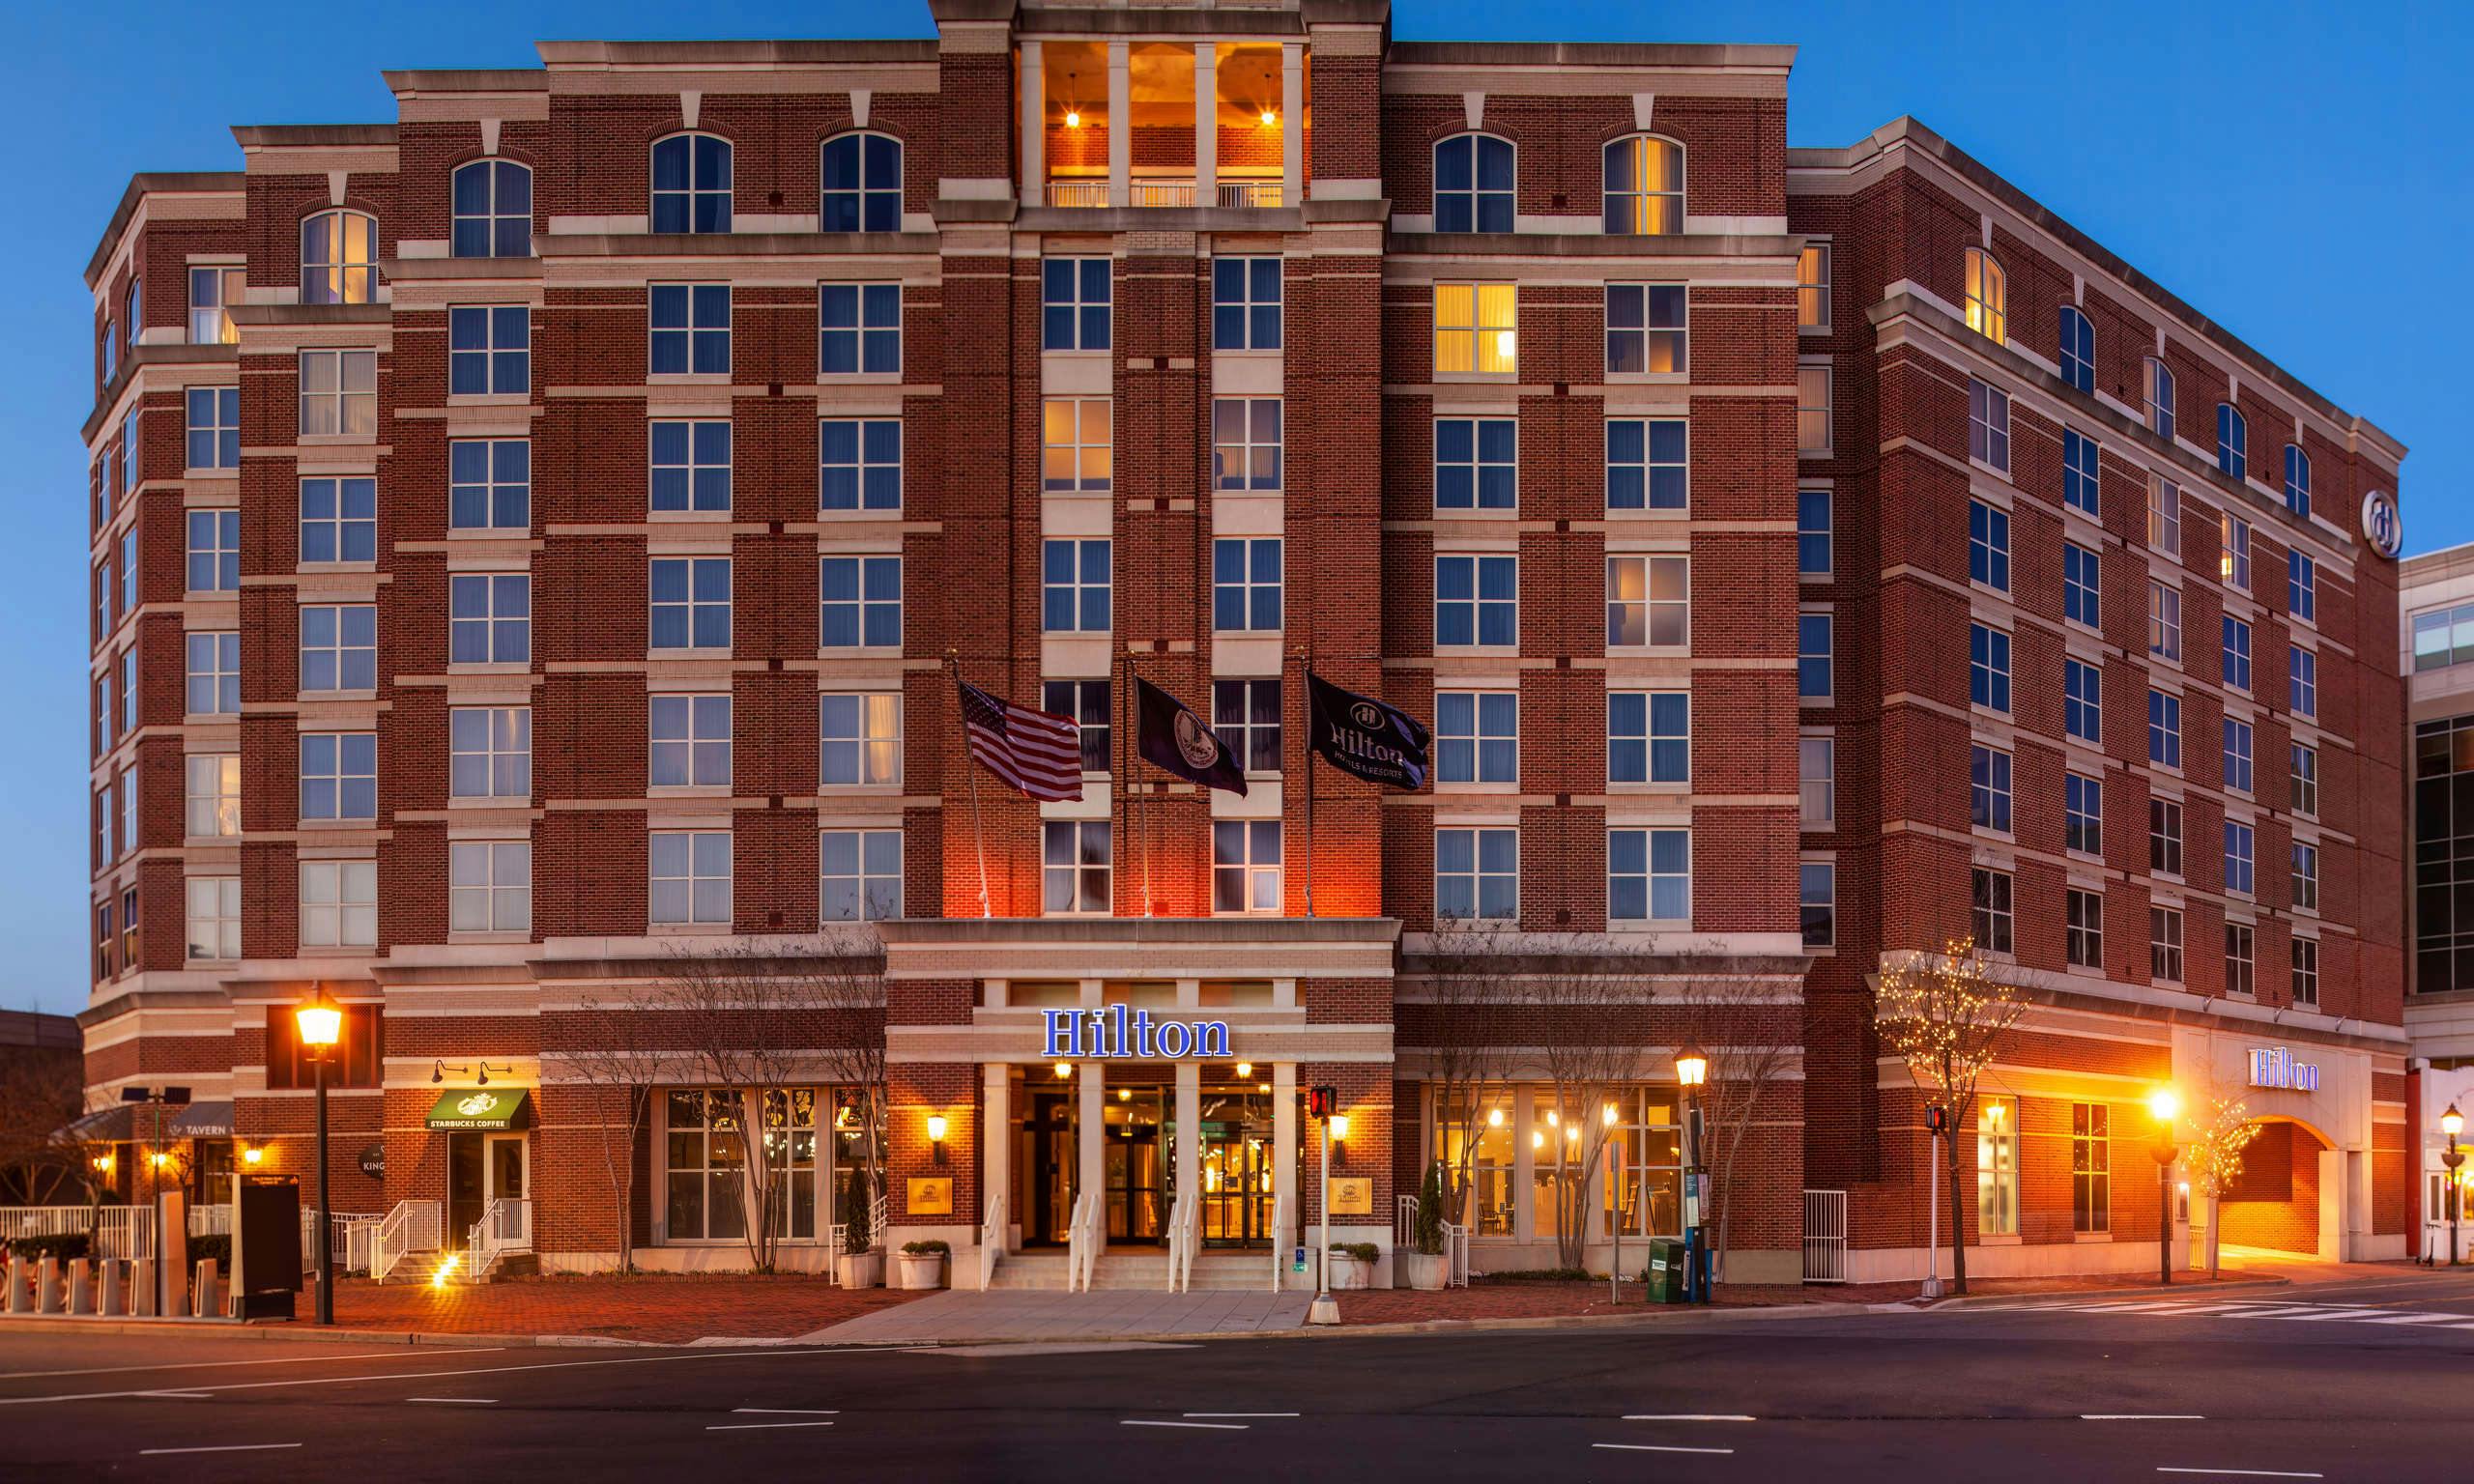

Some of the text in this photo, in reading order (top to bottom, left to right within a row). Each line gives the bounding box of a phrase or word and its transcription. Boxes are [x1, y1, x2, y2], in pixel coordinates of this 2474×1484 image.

[1330, 722, 1404, 767] Hilton
[1041, 1003, 1233, 1059] Hilton
[2248, 1046, 2318, 1091] Hilton
[186, 1125, 226, 1135] TAVERN
[430, 1120, 505, 1128] STARBUCKS COFFEE
[363, 1161, 386, 1171] KING
